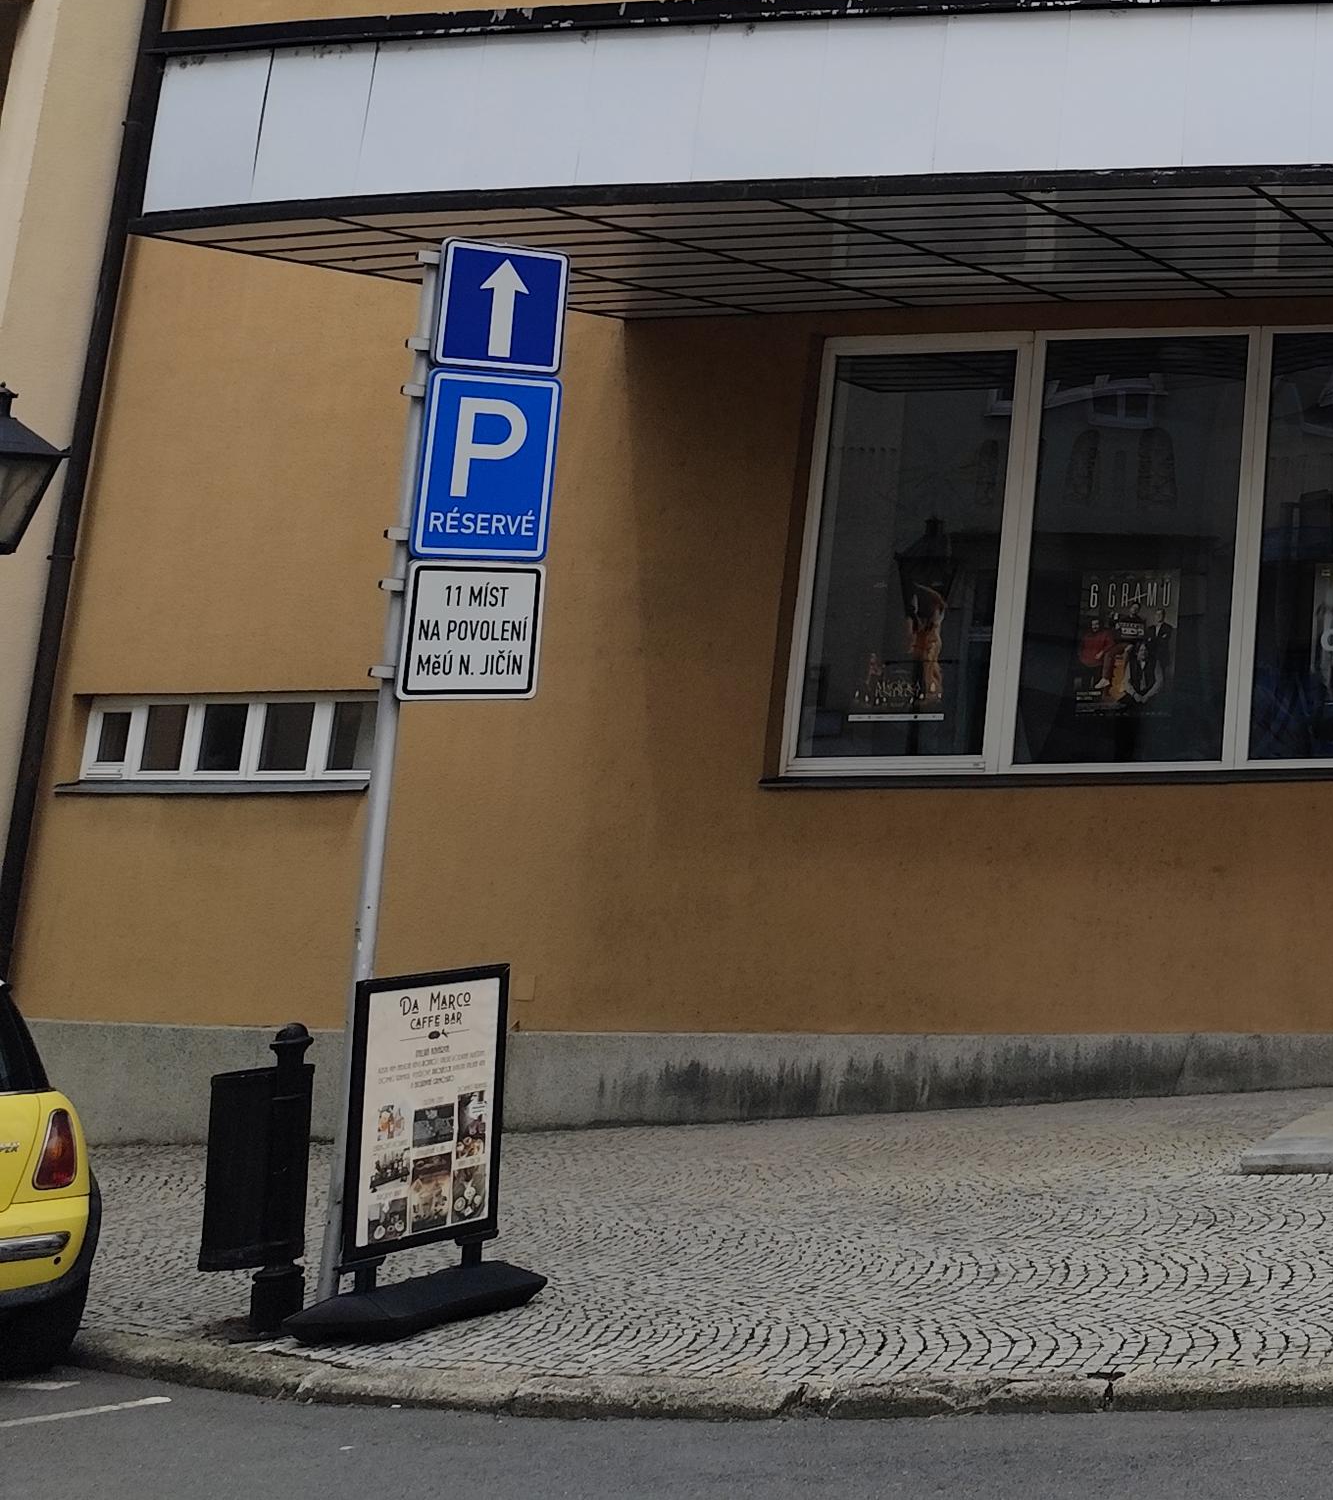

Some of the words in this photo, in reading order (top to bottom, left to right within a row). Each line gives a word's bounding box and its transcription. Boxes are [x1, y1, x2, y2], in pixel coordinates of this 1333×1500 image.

[450, 396, 528, 497] P
[428, 506, 536, 536] RÉSERVÉ
[445, 585, 462, 607] 11
[468, 581, 510, 607] MÍST
[1089, 583, 1100, 609] 6
[418, 619, 441, 641] NA
[446, 616, 528, 641] POVOLENÍ
[416, 650, 453, 676] MěÚ
[458, 654, 474, 676] N.
[479, 649, 523, 676] JIČÍN
[410, 1014, 441, 1030] CAFFE
[444, 1011, 462, 1026] BAR
